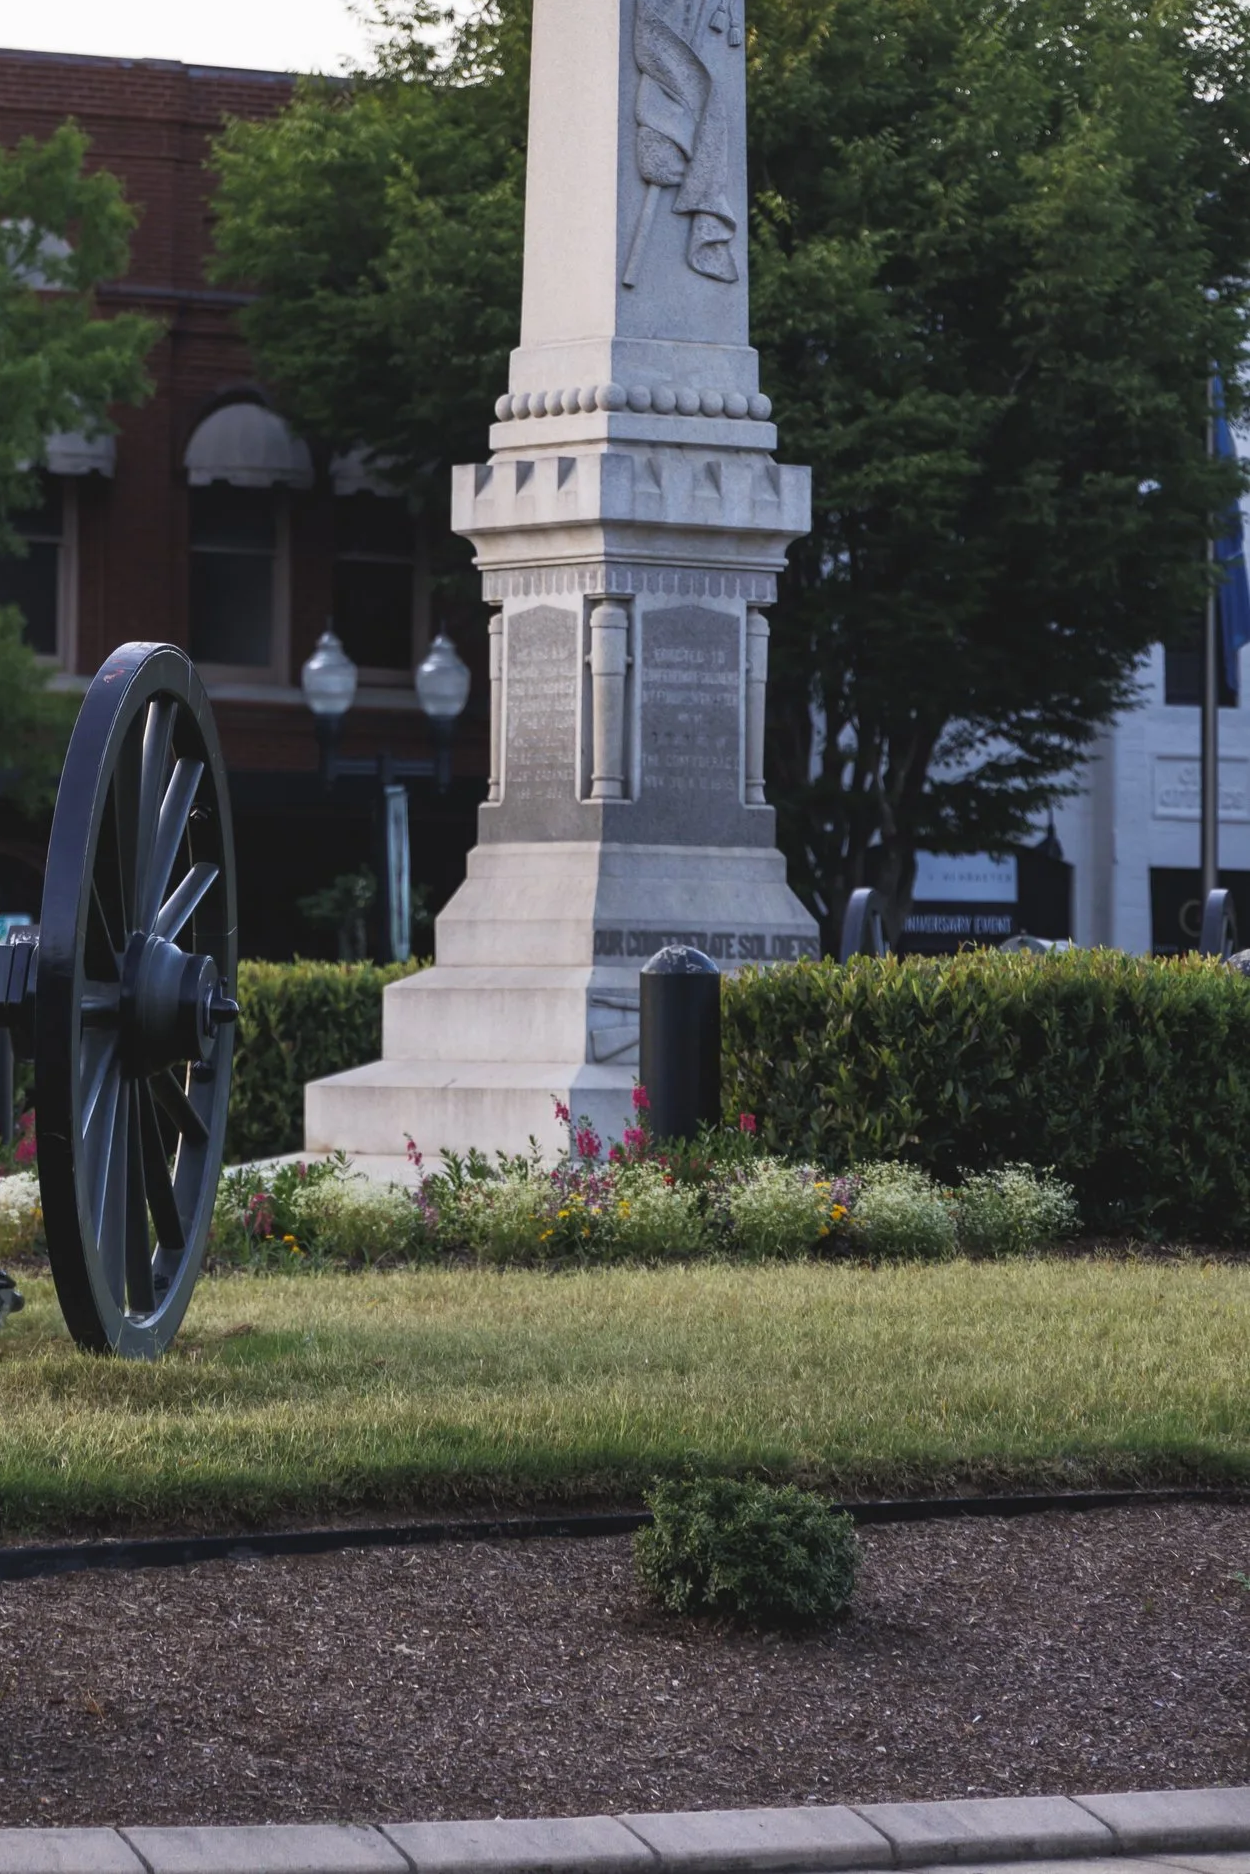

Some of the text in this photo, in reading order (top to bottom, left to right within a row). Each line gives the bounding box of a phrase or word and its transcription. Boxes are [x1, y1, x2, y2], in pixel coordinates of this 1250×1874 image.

[904, 914, 1011, 934] NIVERSARY EVENT
[594, 929, 624, 956] OUR
[738, 932, 819, 962] SOLDIERS
